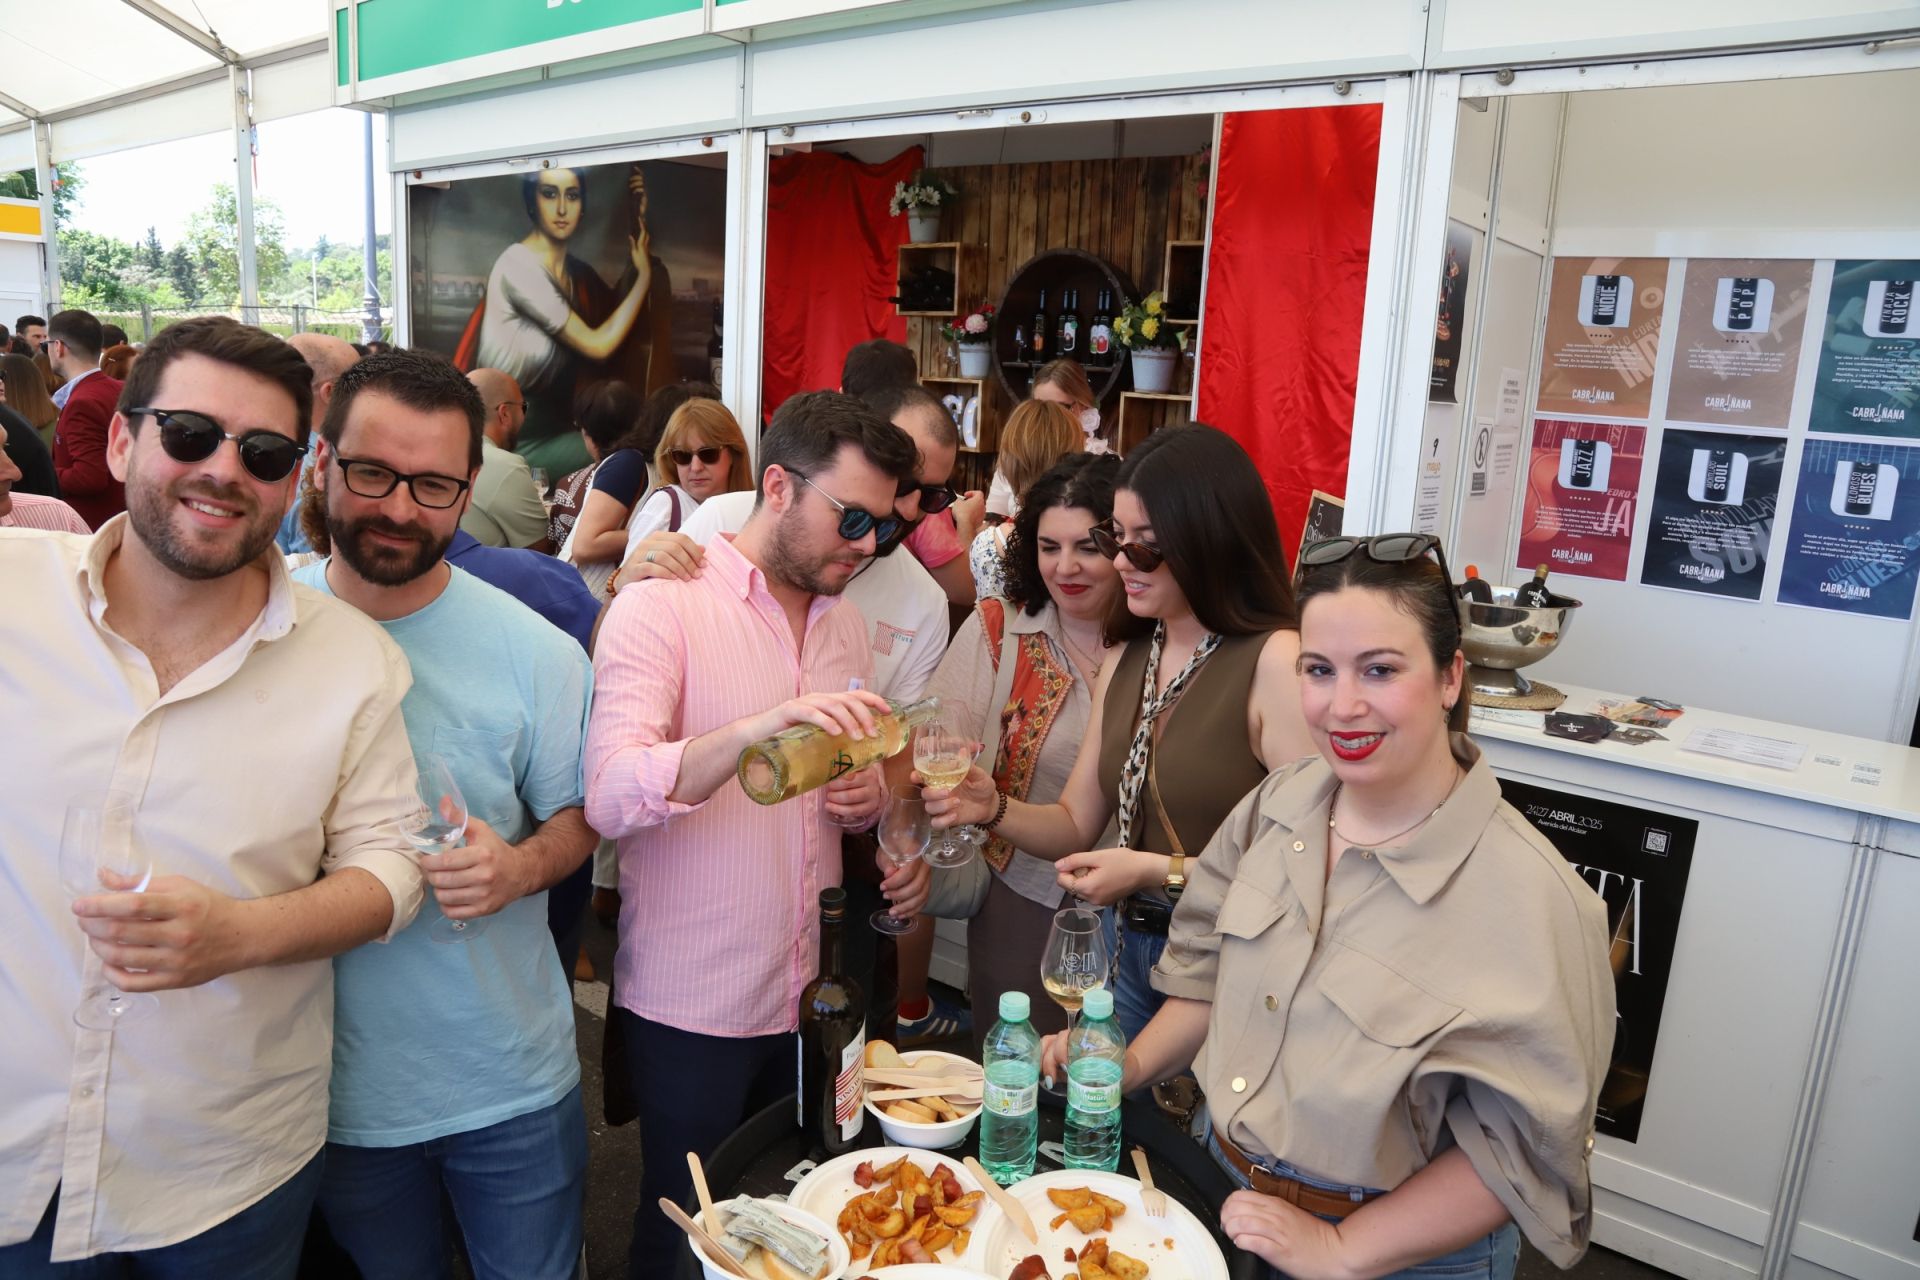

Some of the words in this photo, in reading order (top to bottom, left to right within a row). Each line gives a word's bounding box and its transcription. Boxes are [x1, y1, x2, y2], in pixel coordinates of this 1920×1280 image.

[1598, 285, 1618, 316] INDIE
[1729, 288, 1741, 319] FINO
[1738, 289, 1756, 320] POP
[1881, 291, 1895, 323] TINAJA
[1890, 292, 1911, 324] ROCK
[1576, 449, 1594, 478] JAZZ
[1713, 462, 1730, 490] SOUL
[1847, 471, 1861, 504] OLOROSO
[1857, 472, 1877, 505] BLUES
[1538, 818, 1559, 829] Avenida
[1548, 809, 1578, 825] ABRIL
[1578, 815, 1603, 830] 2025
[838, 1087, 854, 1102] VINO
